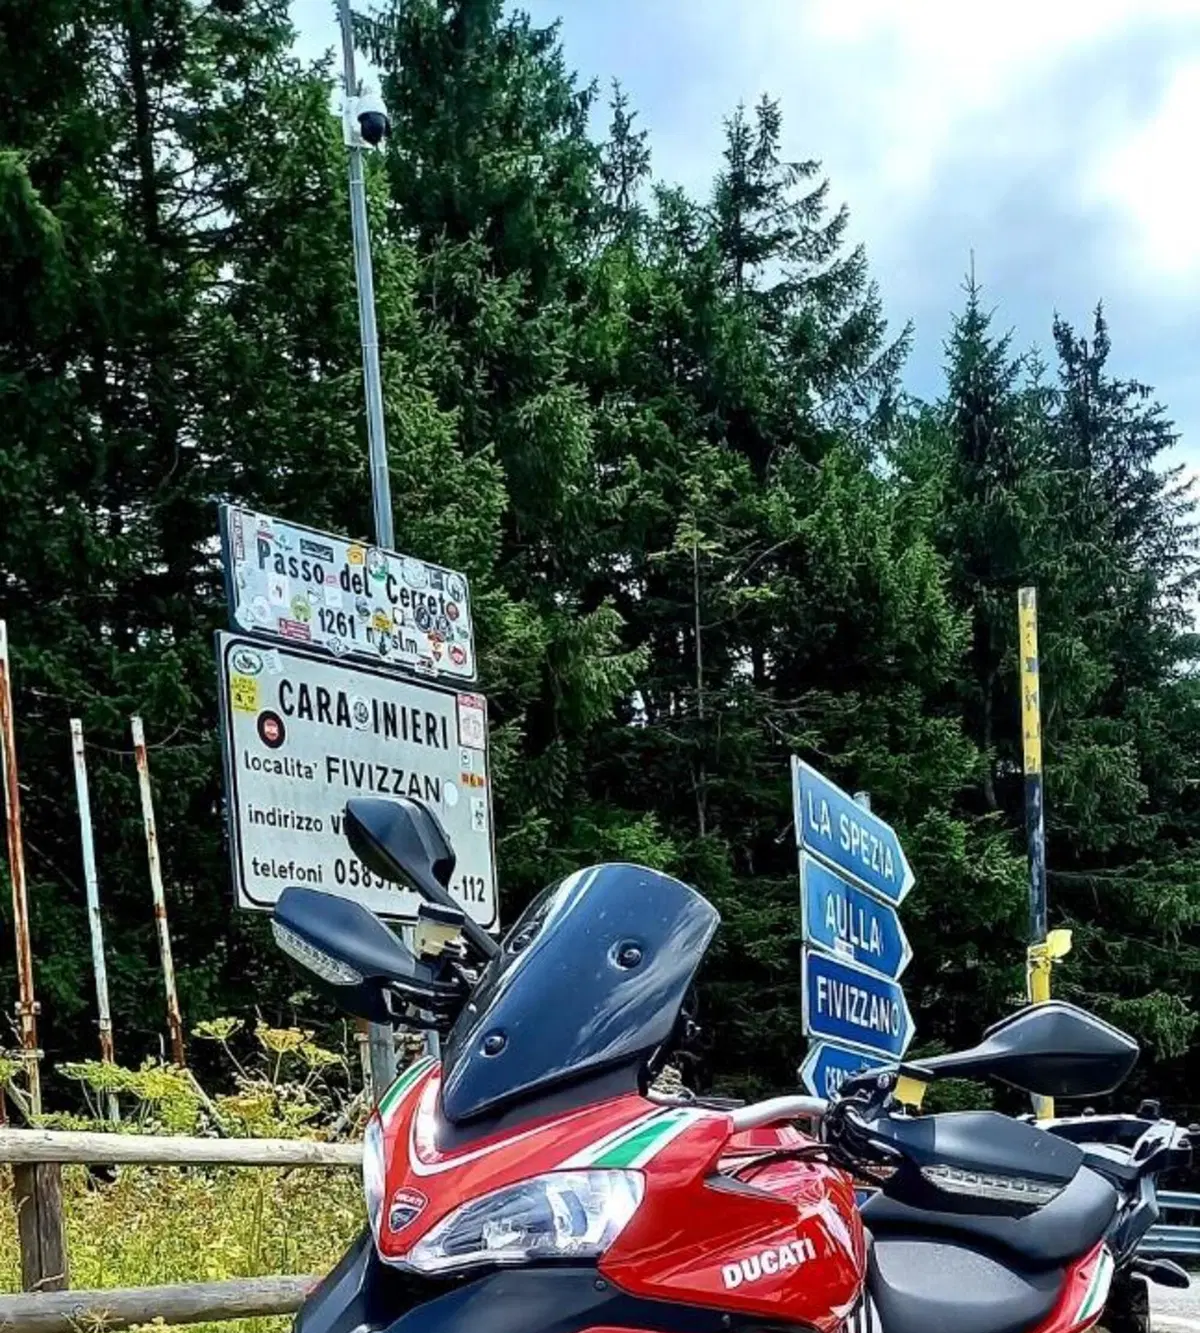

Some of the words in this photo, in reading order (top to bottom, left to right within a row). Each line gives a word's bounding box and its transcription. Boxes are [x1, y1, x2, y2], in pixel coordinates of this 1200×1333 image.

[256, 537, 325, 585] Passo
[339, 562, 374, 598] del
[386, 573, 451, 615] Cerret
[317, 606, 356, 639] 1261
[278, 677, 449, 751] CARAINIERI
[244, 749, 318, 781] localita'
[326, 755, 442, 804] FIVIZZAN
[247, 803, 324, 833] indirizzo
[807, 791, 833, 842] LA
[838, 812, 896, 884] SPEZIA
[251, 856, 323, 884] telefoni
[825, 892, 882, 957] AULLA
[816, 974, 900, 1038] FIVIZZANO
[721, 1237, 817, 1290] DUCATI
